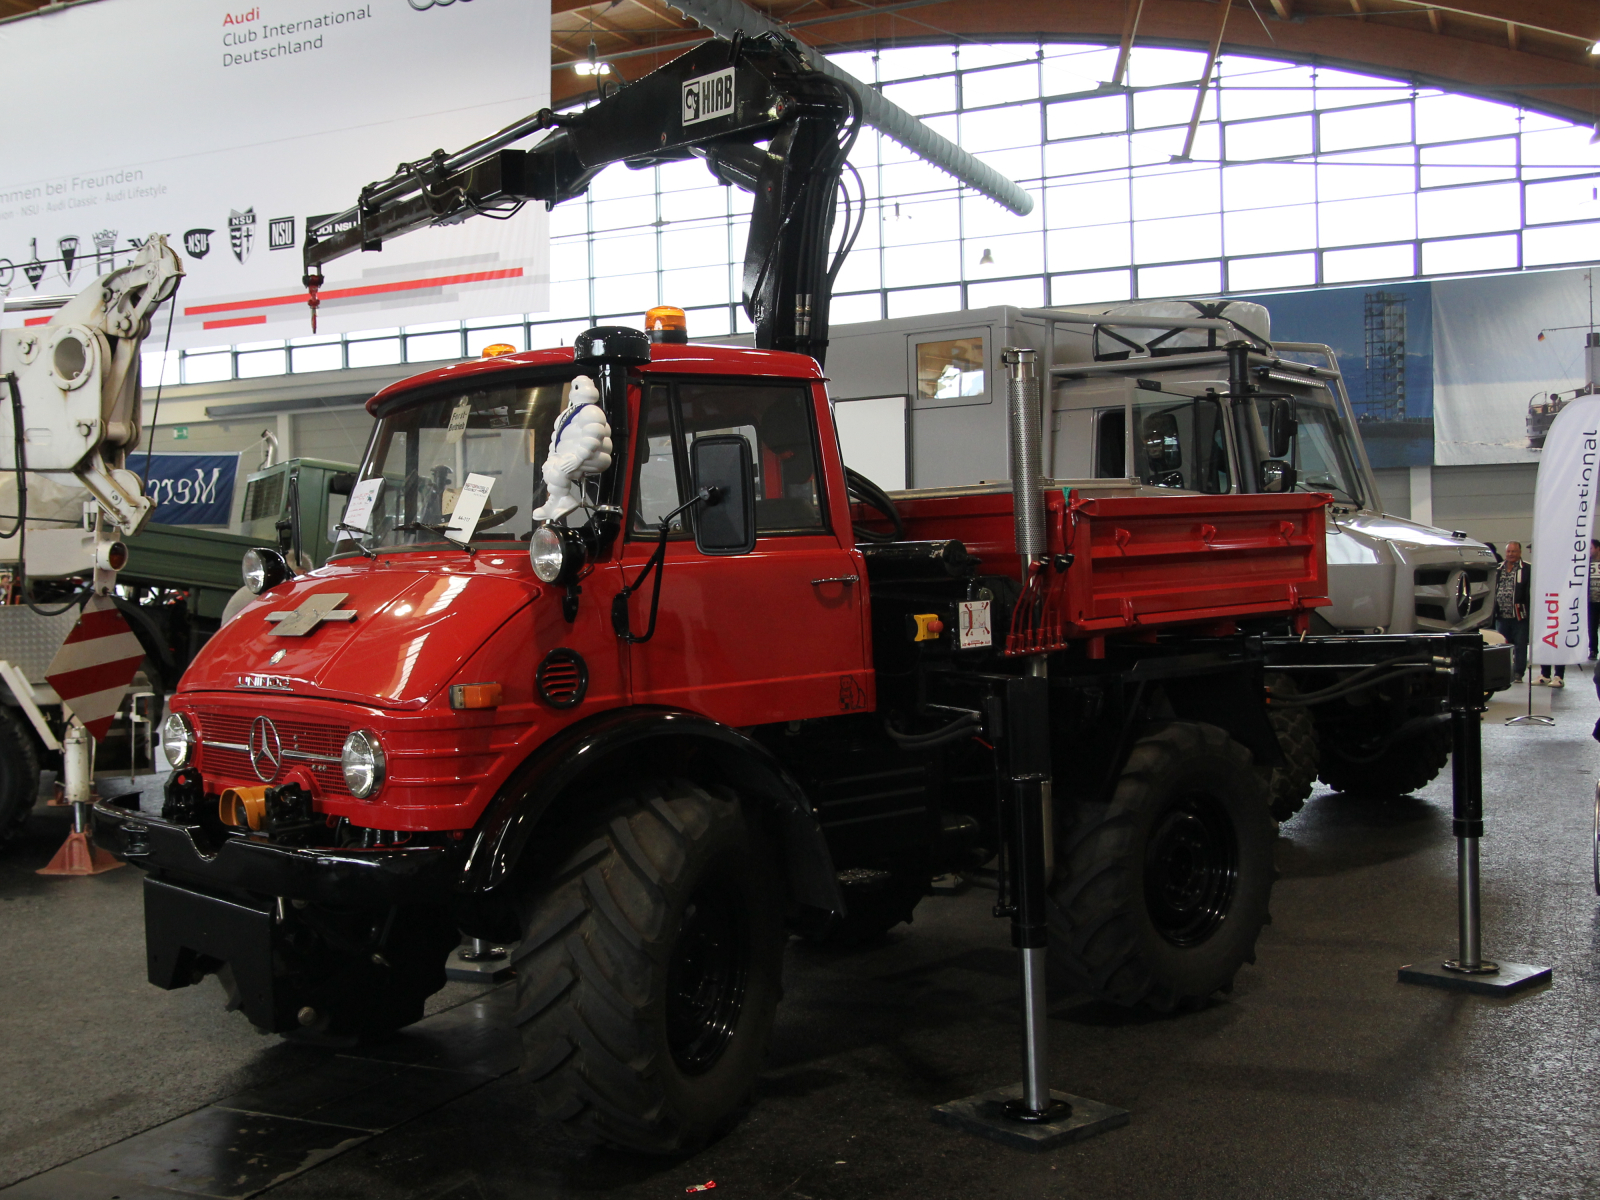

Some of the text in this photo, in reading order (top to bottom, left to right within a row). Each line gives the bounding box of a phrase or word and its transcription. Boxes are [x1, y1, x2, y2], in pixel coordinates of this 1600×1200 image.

[223, 7, 260, 27] Audi
[223, 5, 372, 46] Club International
[223, 34, 323, 67] Deutschland
[702, 74, 733, 115] HIAB
[45, 179, 67, 196] bei
[72, 169, 143, 192] Freunden
[46, 200, 66, 212] Audi
[68, 195, 97, 209] Classic
[105, 189, 126, 203] Audi
[128, 183, 167, 200] Lifestyle
[231, 215, 253, 226] NSU
[271, 221, 292, 246] NSU
[187, 233, 207, 253] NSU
[1569, 429, 1597, 588] International
[1542, 592, 1559, 649] Audi
[1565, 597, 1580, 648] Club
[238, 676, 290, 688] UNIMOG
